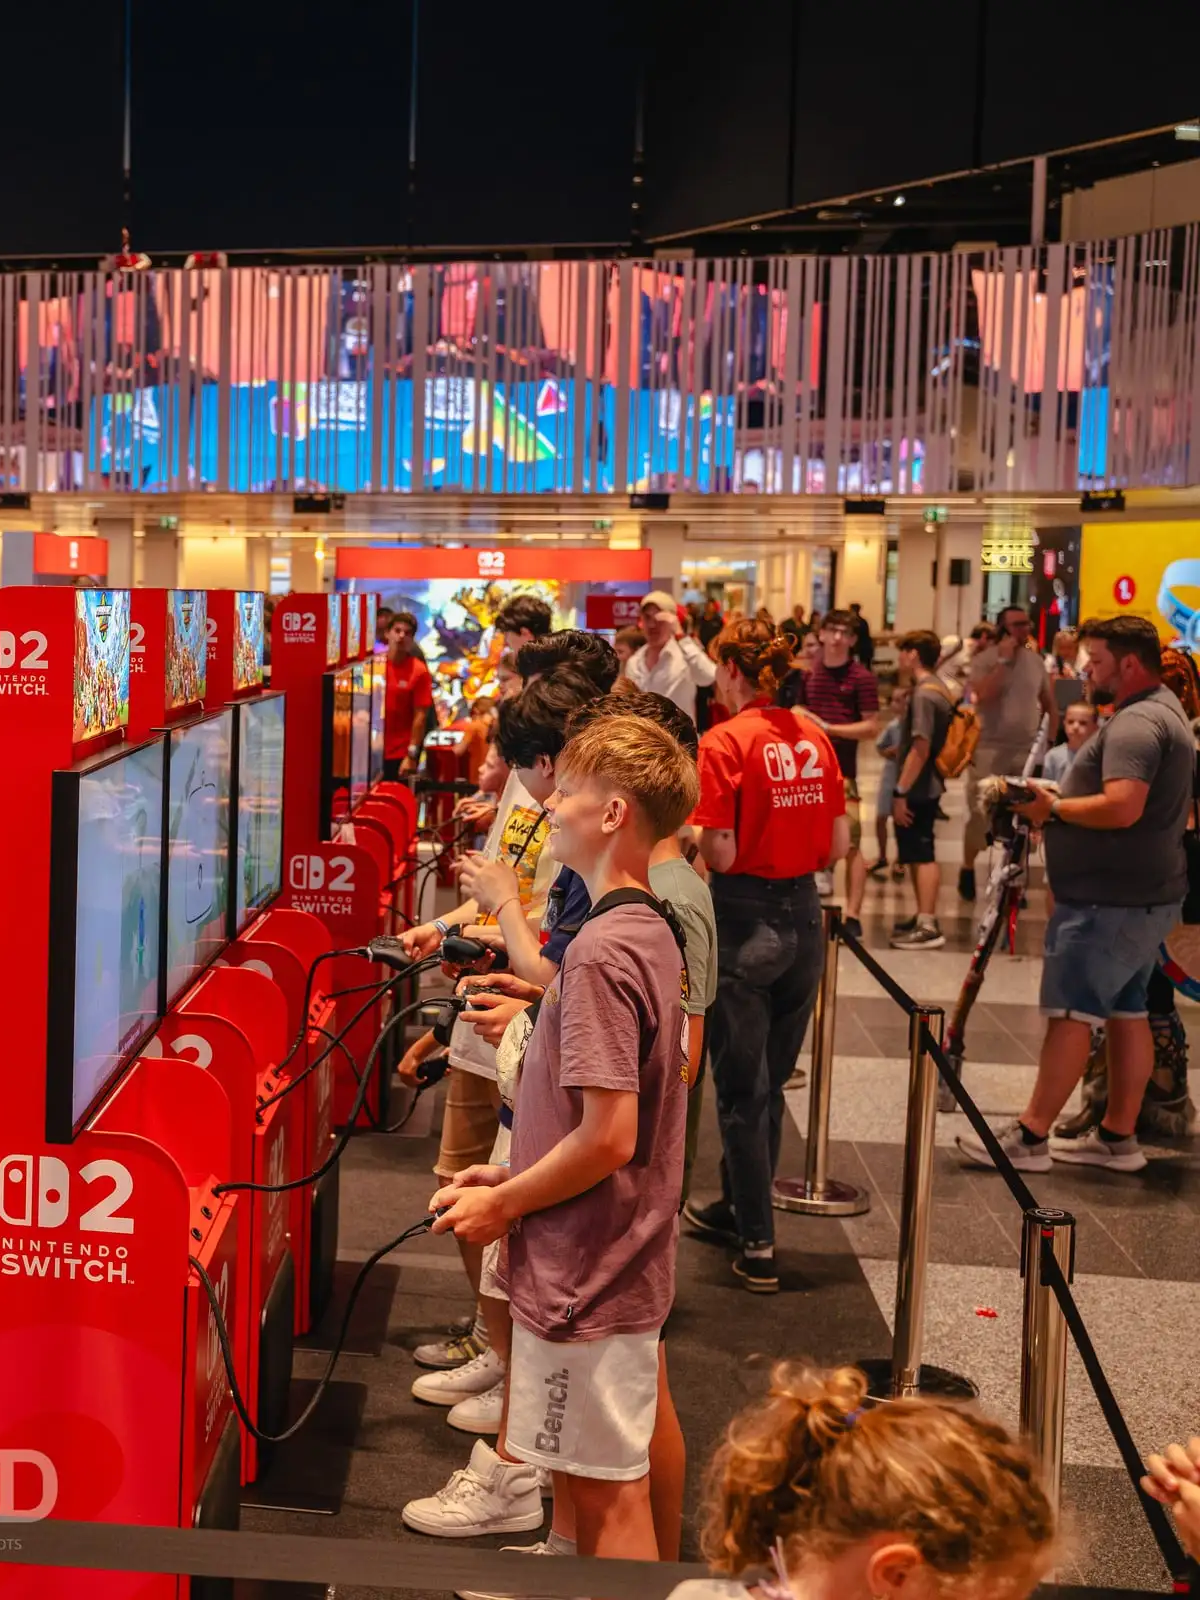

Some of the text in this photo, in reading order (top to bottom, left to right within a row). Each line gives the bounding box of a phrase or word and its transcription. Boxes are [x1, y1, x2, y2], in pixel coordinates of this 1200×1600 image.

[302, 612, 316, 631] 2
[20, 631, 48, 669] 2
[794, 740, 823, 778] 2
[772, 784, 822, 795] NINTENDO
[773, 792, 824, 808] SWITCH
[328, 856, 355, 891] 2
[291, 894, 352, 903] NINTENDO
[291, 901, 352, 914] SWITCH
[79, 1159, 135, 1235] 2
[2, 1237, 128, 1259] NINTENDO
[535, 1368, 569, 1454] Bench.
